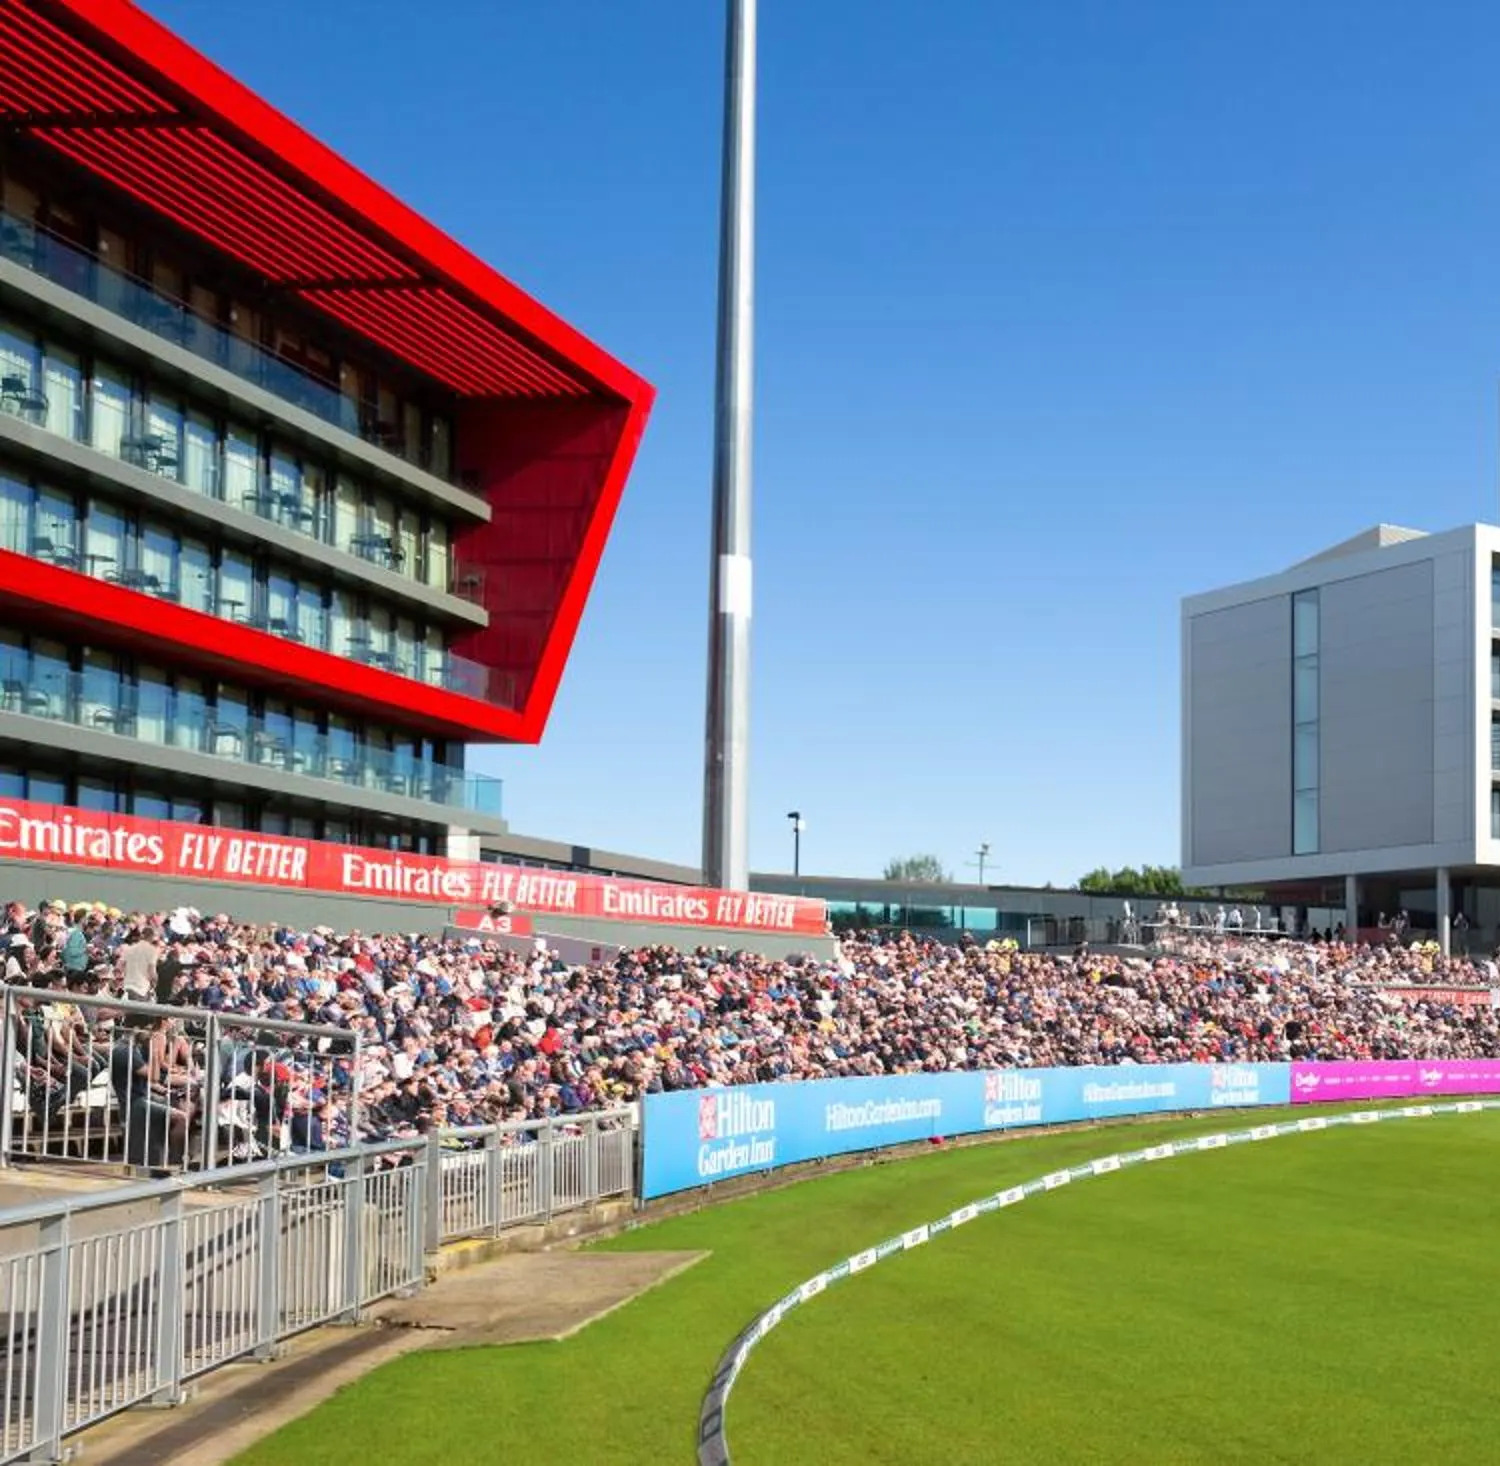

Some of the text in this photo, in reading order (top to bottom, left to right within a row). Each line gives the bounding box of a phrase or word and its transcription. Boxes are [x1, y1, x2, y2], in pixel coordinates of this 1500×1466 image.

[0, 807, 308, 882] Emirates FLY BETTER
[342, 853, 577, 908] Emirates FLY BETTER
[478, 914, 512, 933] A3
[602, 883, 795, 928] Emirates FLY BETTER
[1000, 1071, 1041, 1101] Hilton
[1223, 1063, 1259, 1088] Hilton
[715, 1092, 775, 1138] Hilton
[698, 1137, 775, 1176] Garden Inn
